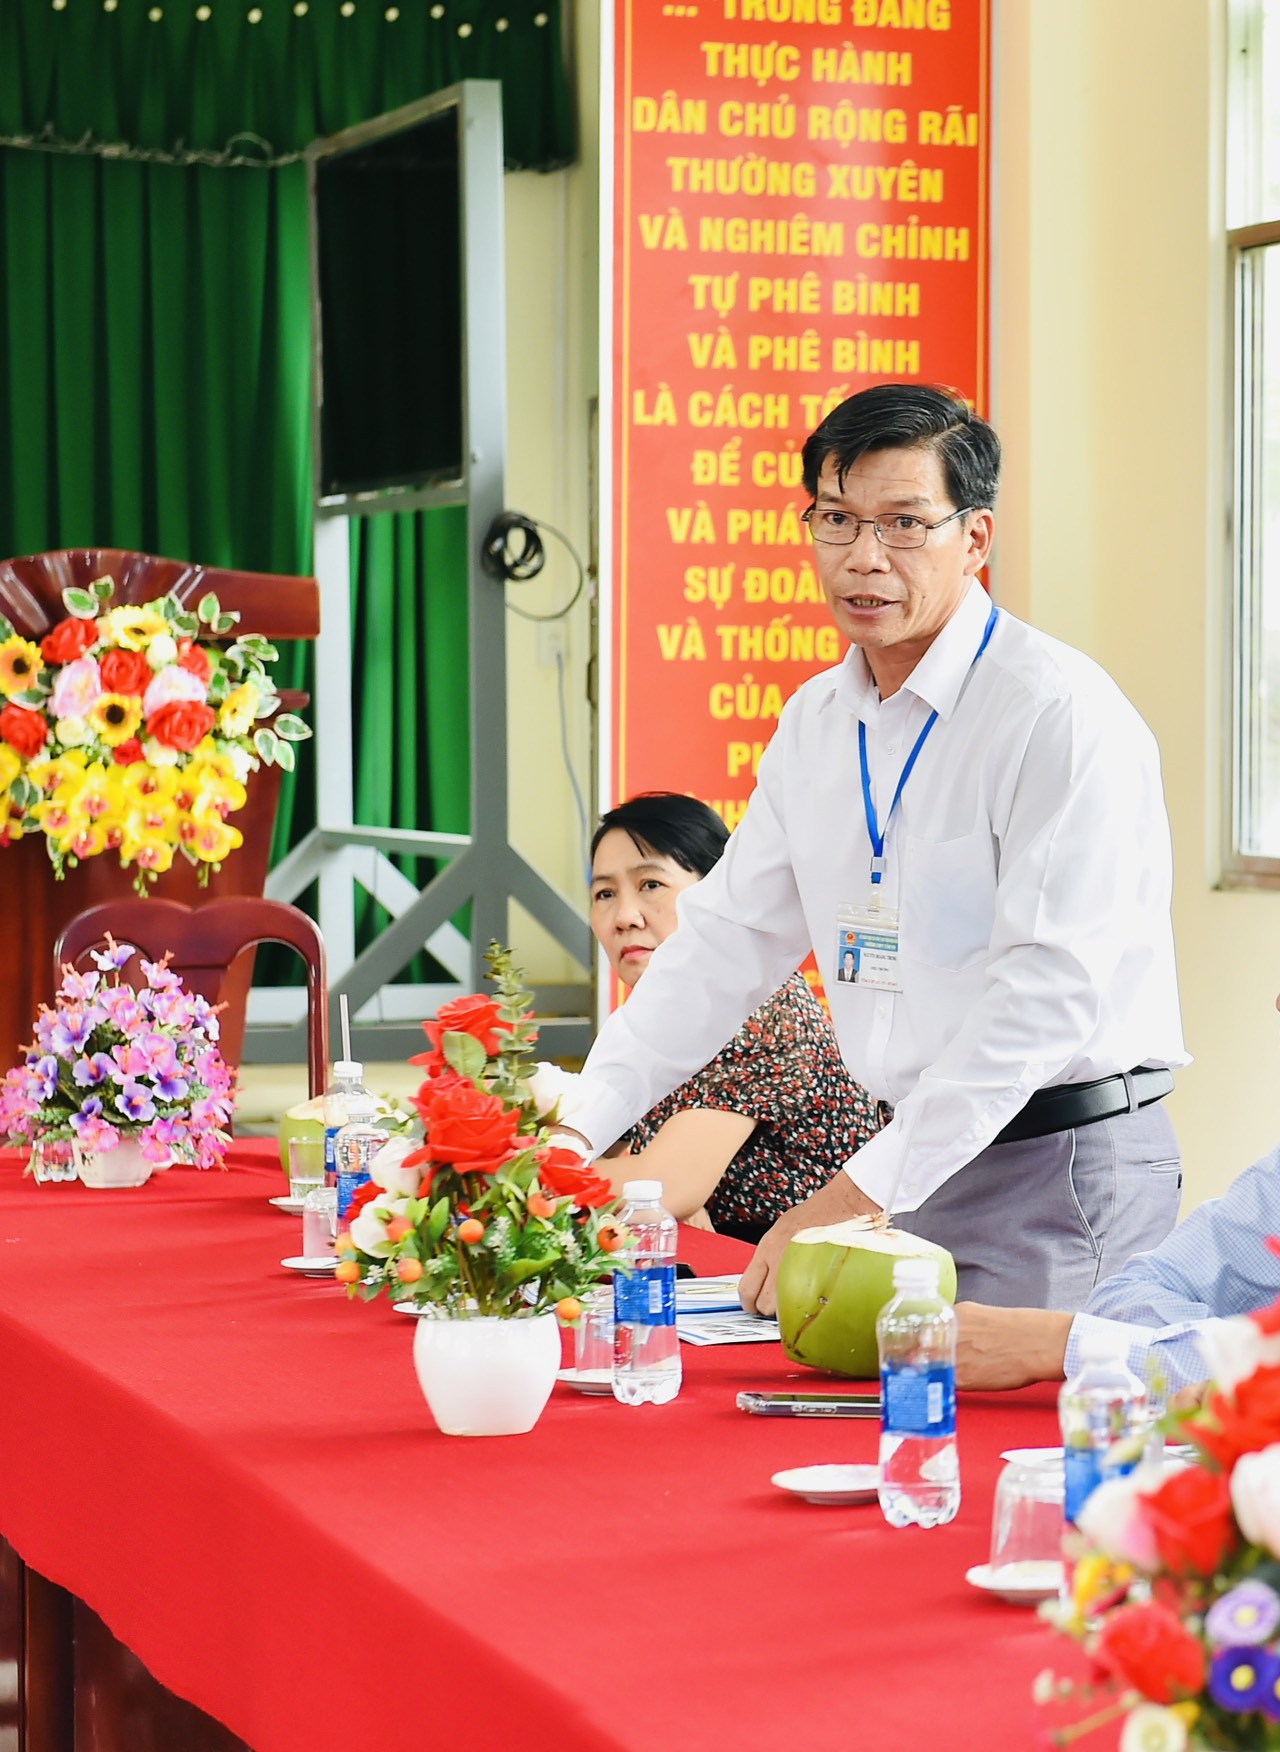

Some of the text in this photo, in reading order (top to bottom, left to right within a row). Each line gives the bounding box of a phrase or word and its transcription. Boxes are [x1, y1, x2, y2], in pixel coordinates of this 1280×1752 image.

[701, 41, 912, 87] THỰC HÀNH
[632, 90, 978, 148] DÂN CHỦ RỘNG RÃI
[666, 153, 944, 202] THƯỜNG XUYÊN
[639, 207, 970, 261] VÀ NGHIÊM CHỈNH
[689, 272, 920, 318] TỰ PHÊ BÌNH
[688, 326, 920, 375] VÀ PHÊ BÌNH
[633, 383, 850, 431] LÀ CÁCH TỐ
[691, 437, 743, 487] ĐỂ
[666, 500, 815, 546] VÀ PHÁ
[683, 562, 737, 610] SỰ
[656, 614, 841, 662] VÀ THỐNG
[709, 673, 782, 720] CỦA
